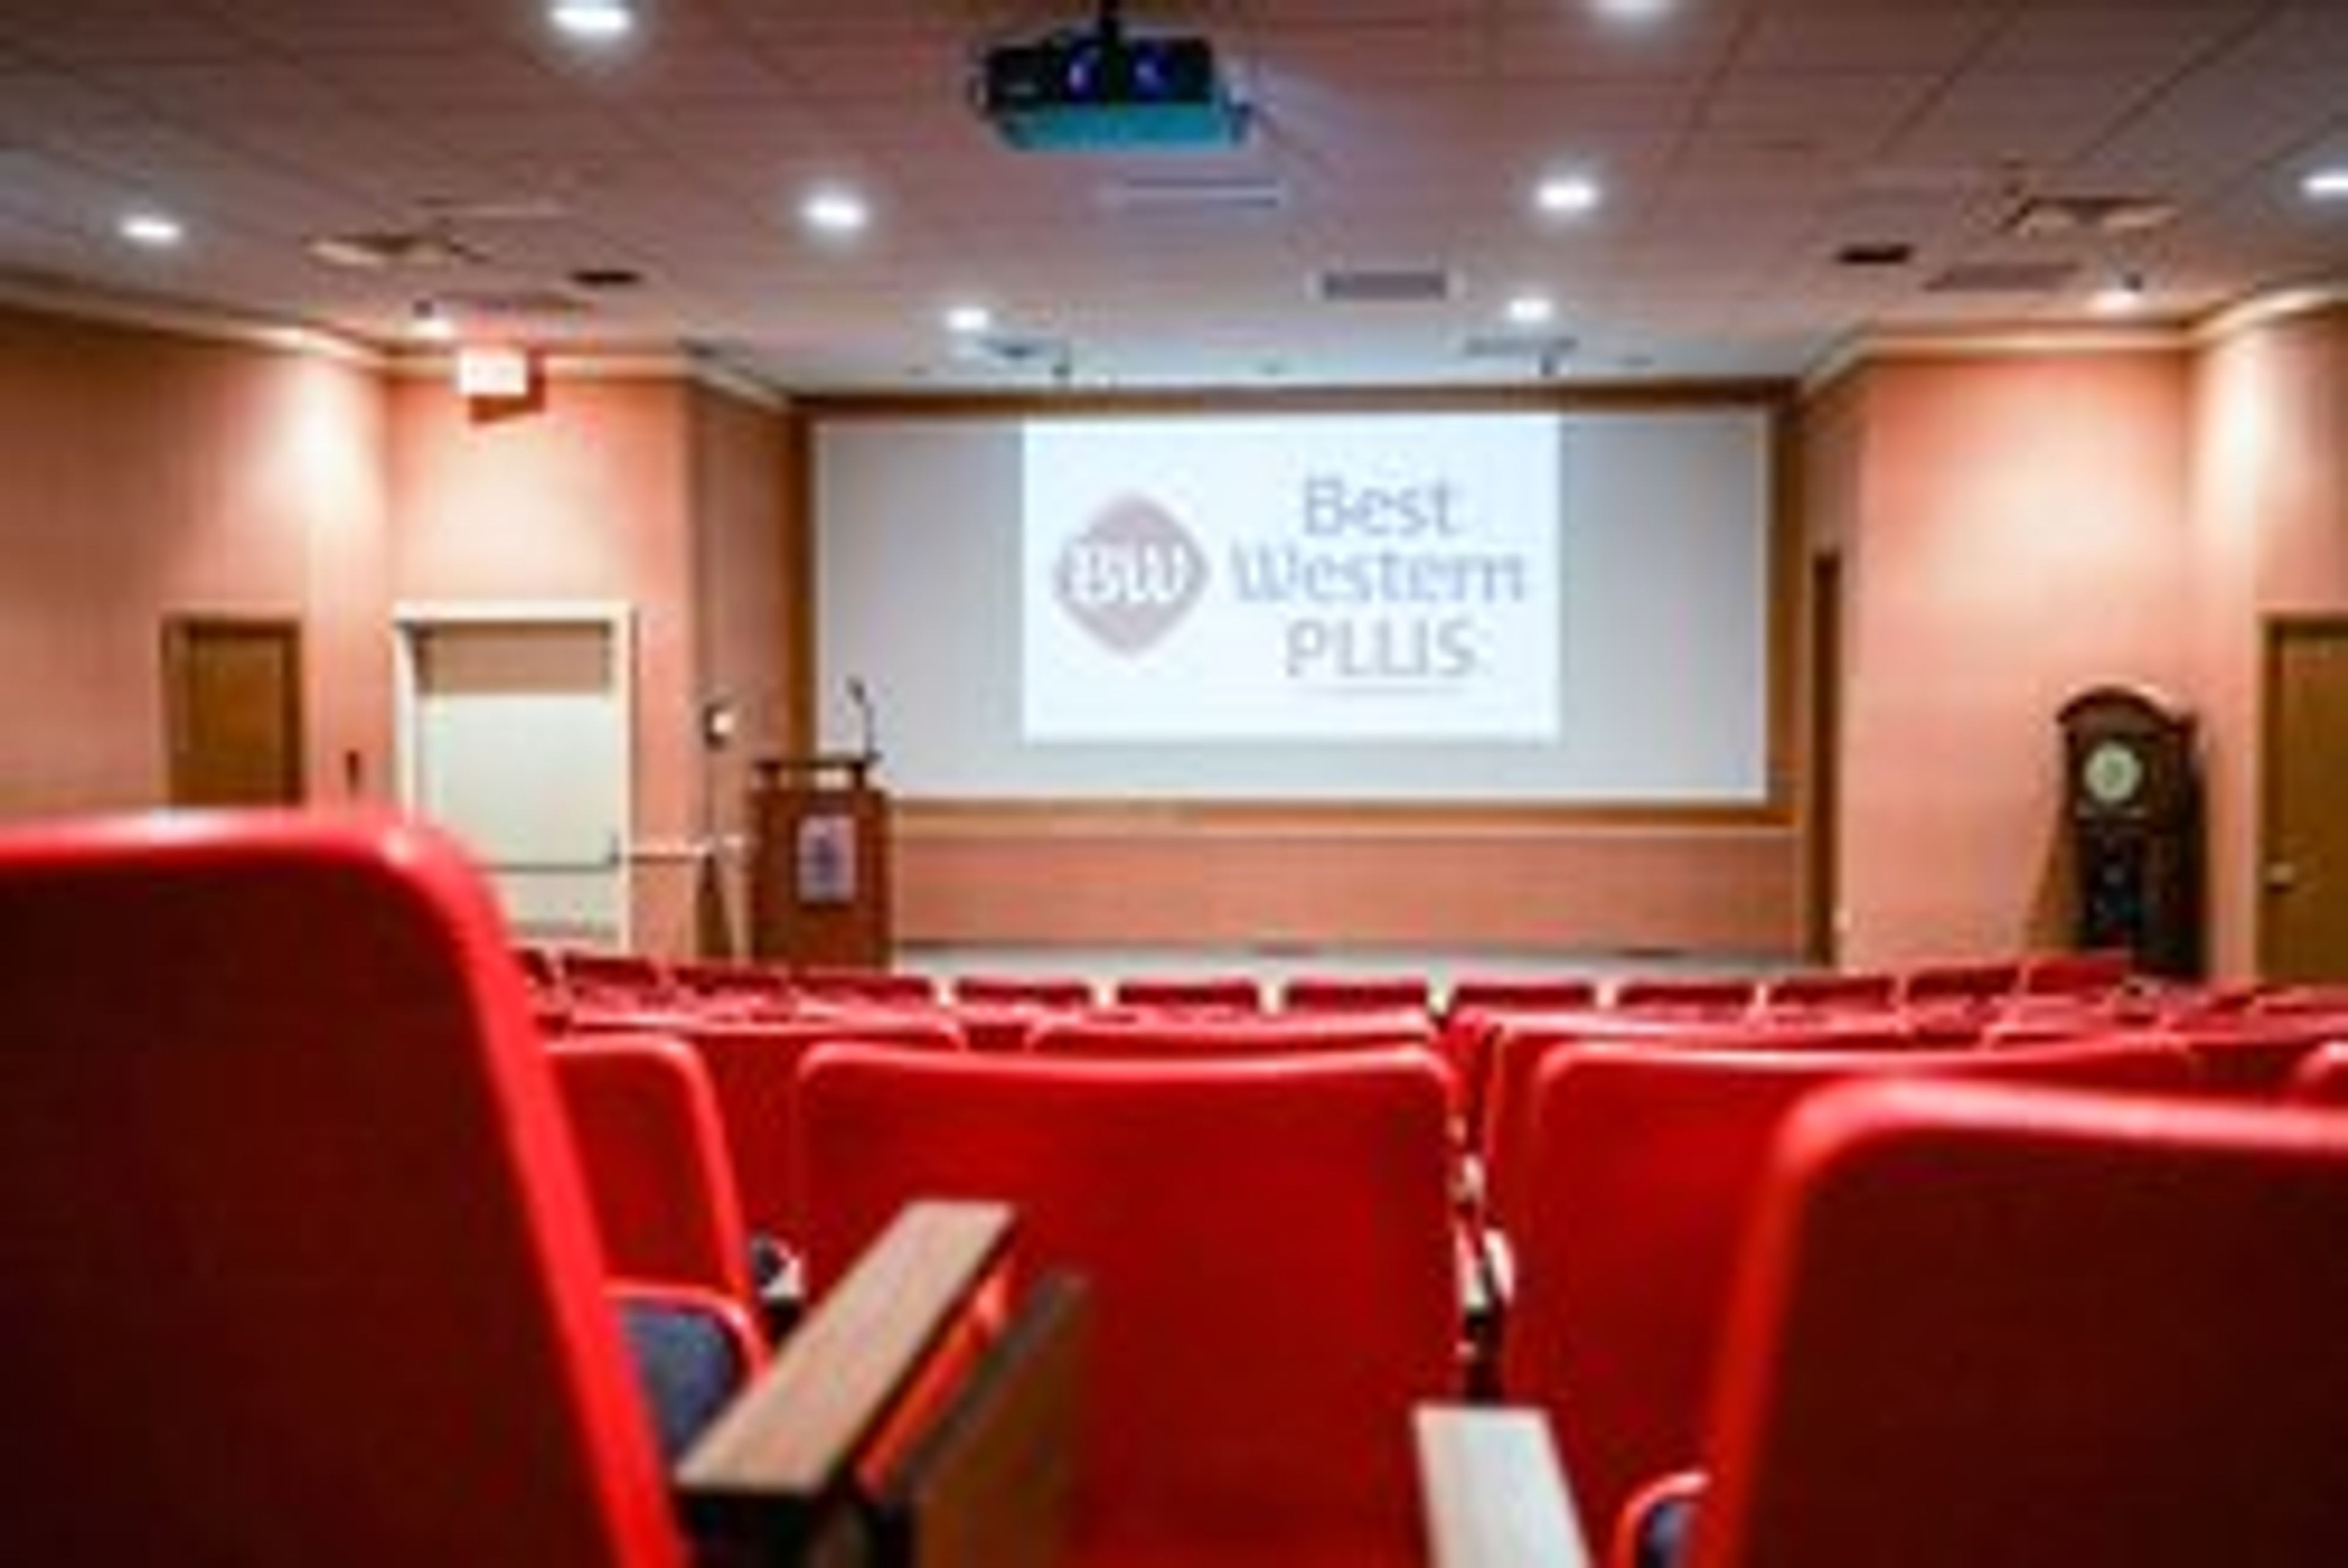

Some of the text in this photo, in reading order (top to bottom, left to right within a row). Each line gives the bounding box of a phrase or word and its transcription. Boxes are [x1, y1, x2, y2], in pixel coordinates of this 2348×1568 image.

[1302, 473, 1460, 536] Best
[1070, 539, 1188, 605] BW
[1230, 542, 1526, 602] Western
[1285, 618, 1479, 677] PLUS
